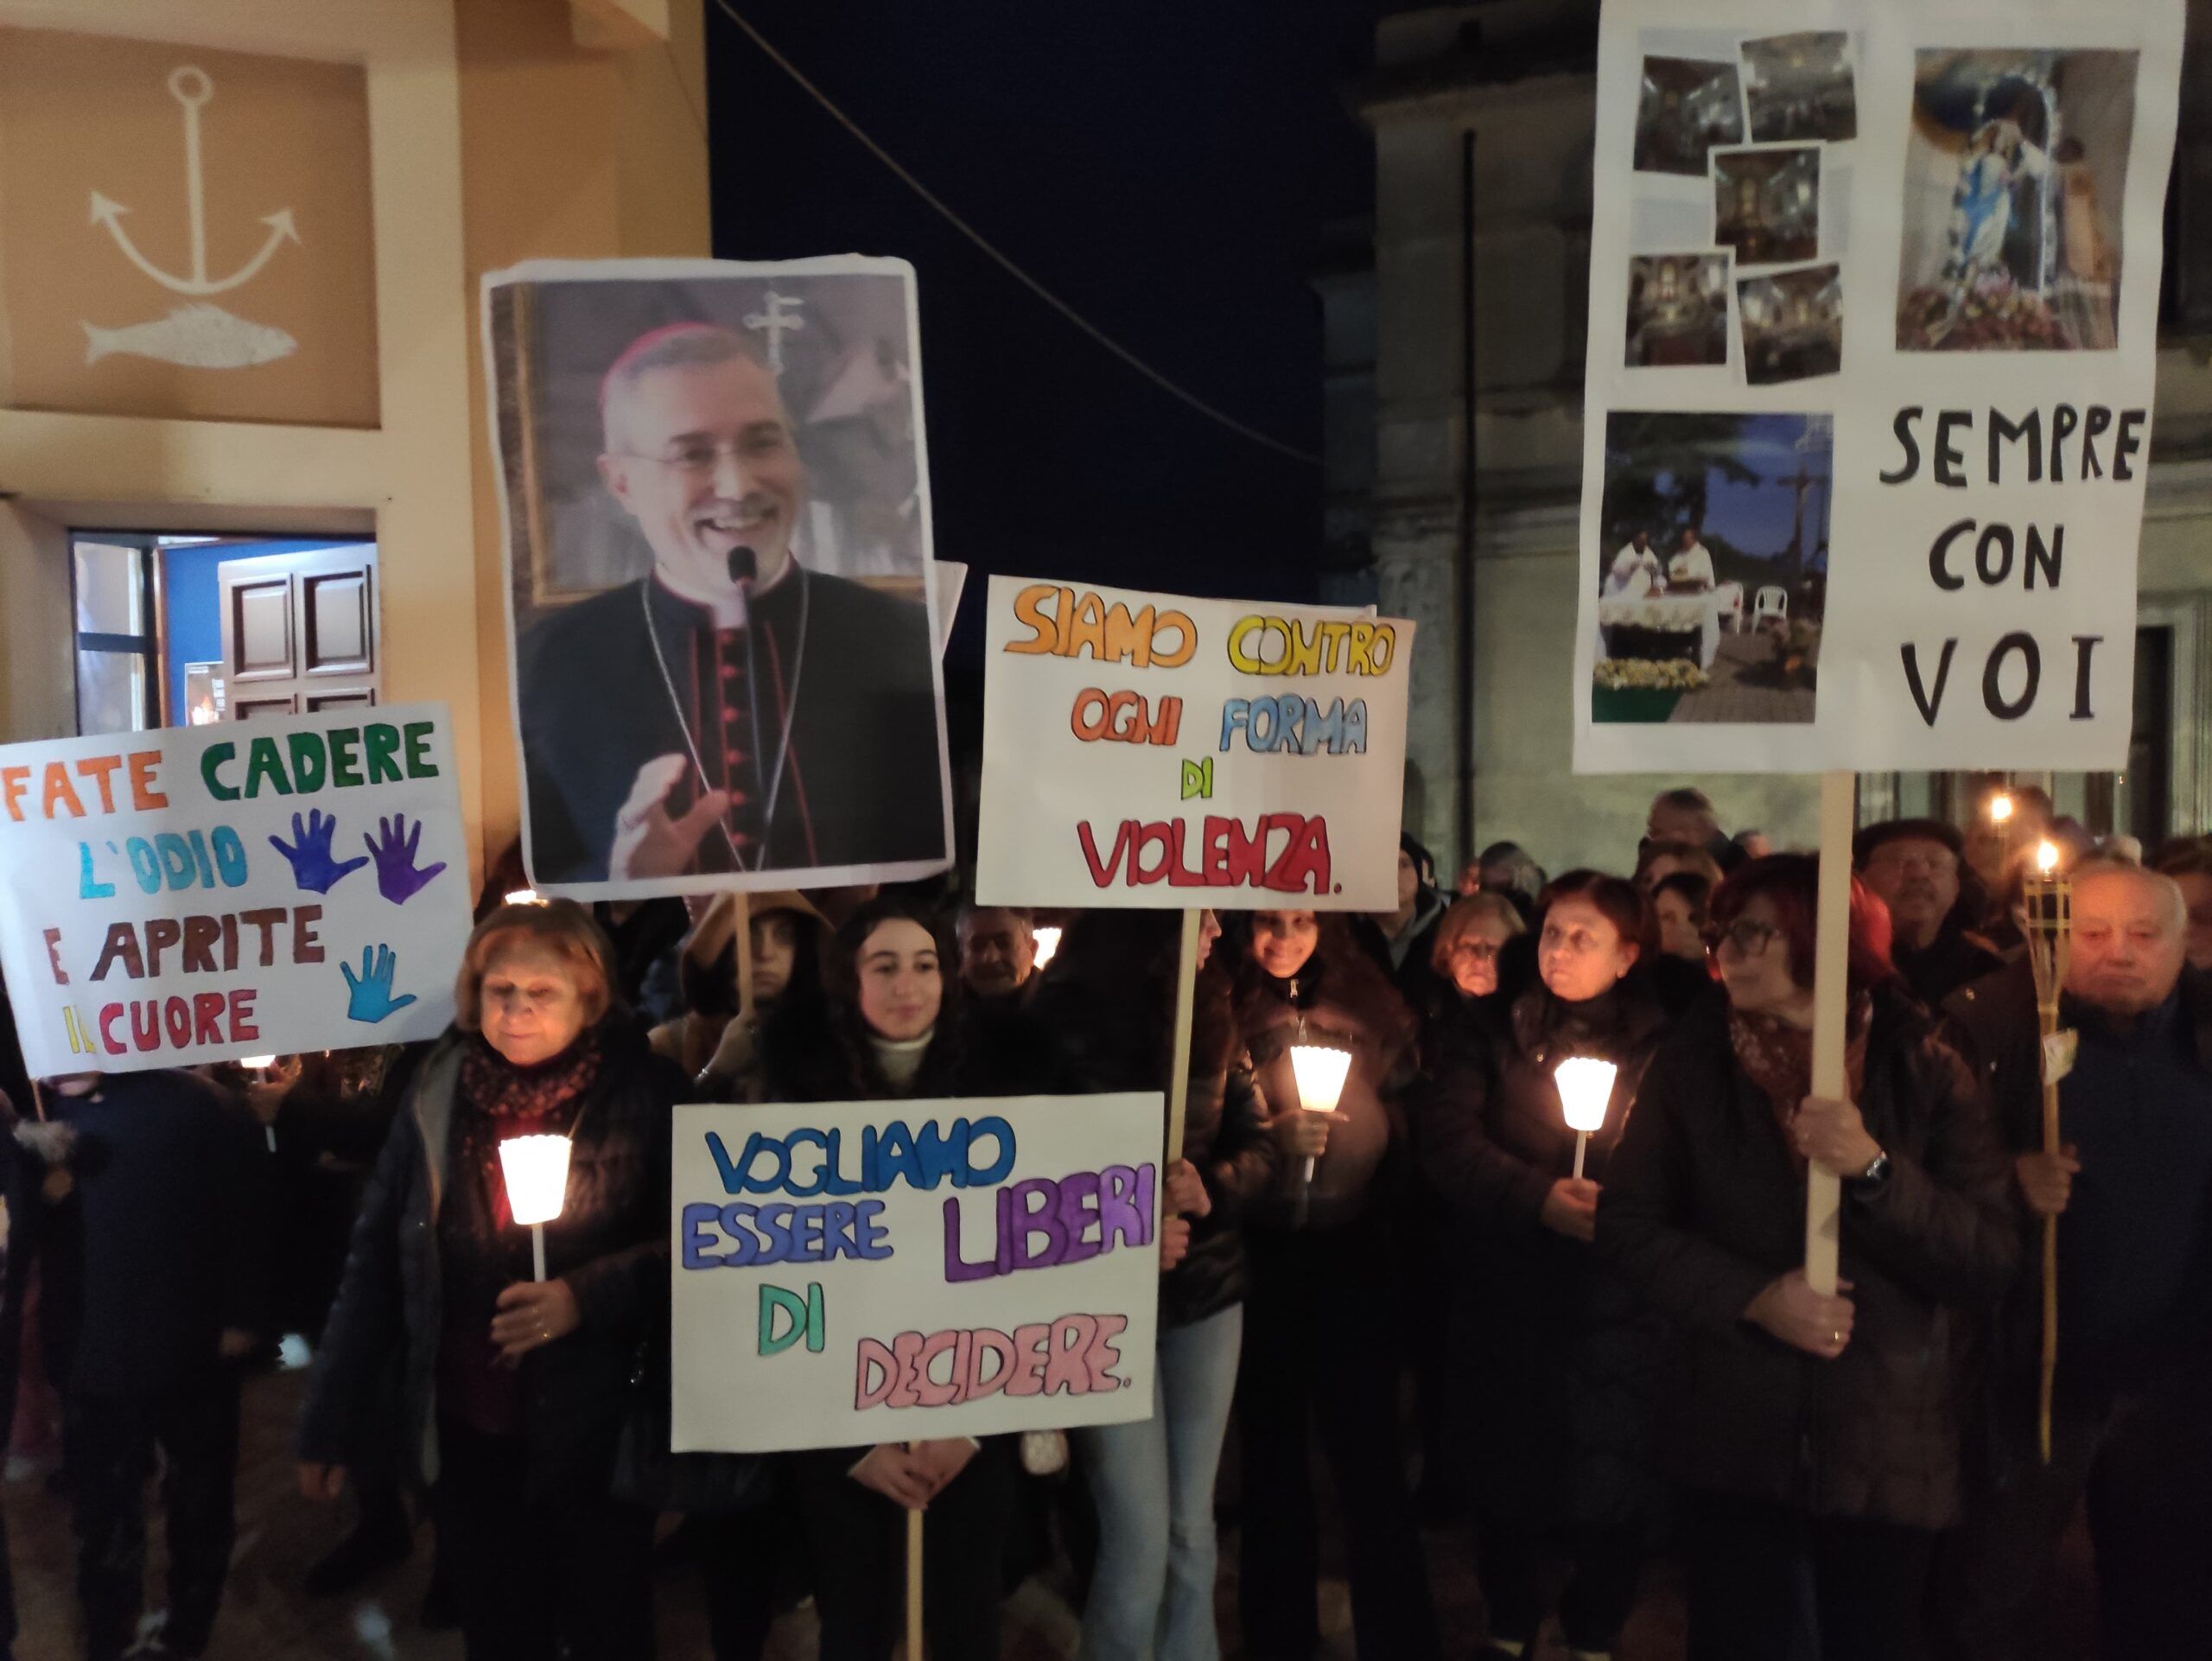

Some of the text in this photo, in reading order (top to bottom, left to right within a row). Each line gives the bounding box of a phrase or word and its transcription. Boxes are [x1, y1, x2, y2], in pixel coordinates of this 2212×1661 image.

[1879, 403, 2146, 487] SEMPRE
[1929, 519, 2064, 591] CON
[1003, 584, 1395, 676] SIAMO CONTRO
[1071, 687, 1367, 755] OGNI FORMA
[1901, 630, 2104, 729] VOI
[1, 722, 439, 822] FATE CADERE
[1181, 756, 1213, 800] DI
[79, 825, 248, 900] L'ODIO
[1077, 811, 1342, 895] VIOLENZA.
[43, 904, 325, 986] E APRITE
[99, 989, 259, 1055] CUORE
[704, 1116, 1016, 1197] VOGLIAMO
[682, 1162, 1156, 1282] ESSERE LIBERI
[758, 1282, 1131, 1411] DI DECIDERE.
